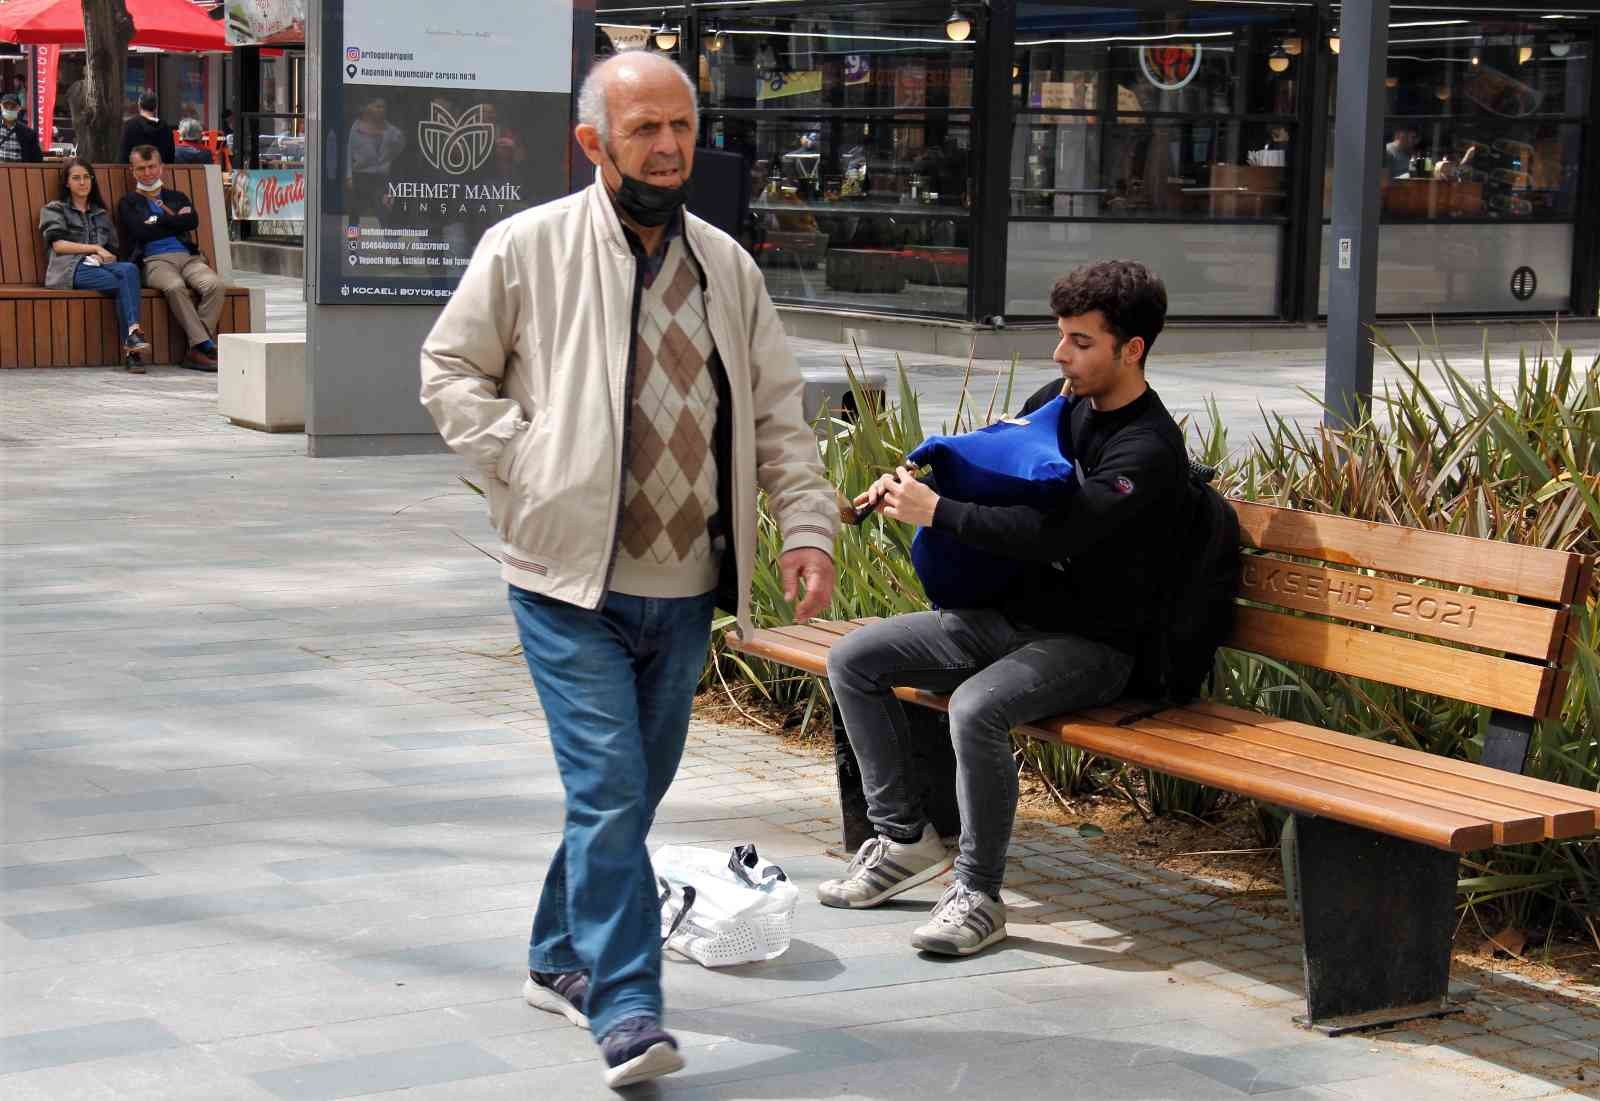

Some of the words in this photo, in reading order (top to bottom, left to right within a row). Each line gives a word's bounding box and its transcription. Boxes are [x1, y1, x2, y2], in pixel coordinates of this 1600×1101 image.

[387, 182, 460, 199] MEHMET
[465, 182, 521, 201] MAMİK
[1391, 591, 1478, 629] 2021
